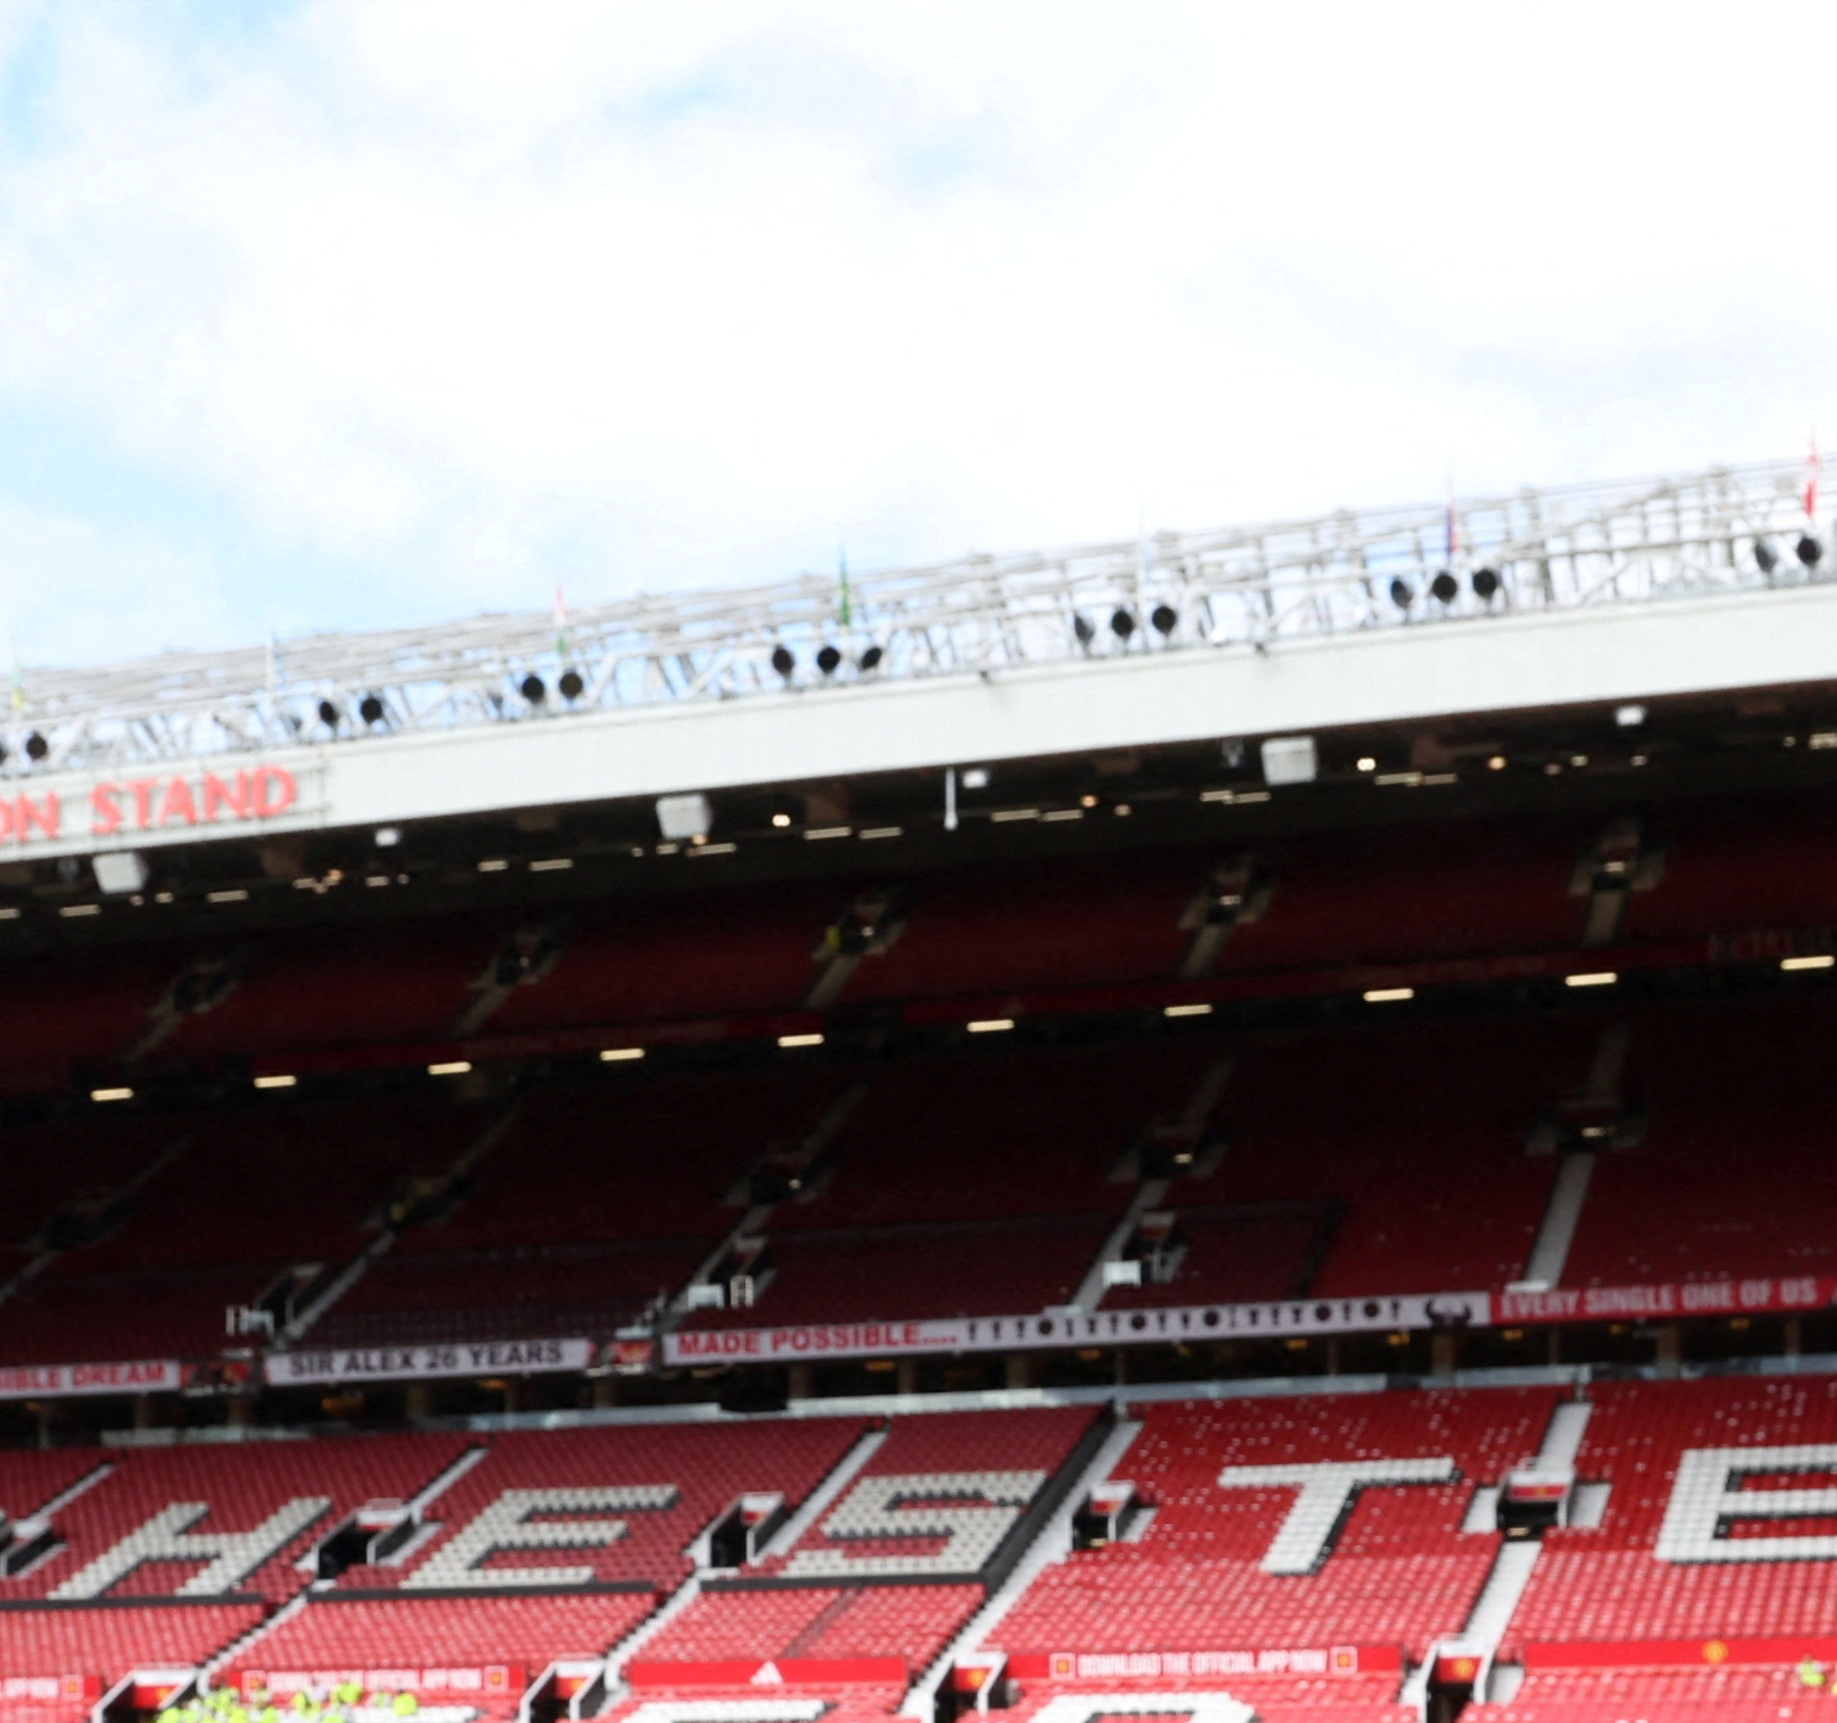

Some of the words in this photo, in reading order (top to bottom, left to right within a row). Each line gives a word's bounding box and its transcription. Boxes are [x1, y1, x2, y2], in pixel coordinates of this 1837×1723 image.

[90, 765, 297, 836] STAND
[1586, 1286, 1673, 1313] SINGLE
[1683, 1283, 1732, 1308] ONE
[1740, 1280, 1771, 1305] OF
[1780, 1278, 1817, 1304] US
[290, 1353, 334, 1376] SIR
[343, 1350, 415, 1373] ALEX
[425, 1348, 456, 1369] 26
[470, 1341, 562, 1367] YEARS
[678, 1331, 760, 1356] MADE
[72, 1361, 165, 1387] DREAM
[1077, 1653, 1161, 1678] DOWNLOAD
[1162, 1652, 1191, 1676] THE
